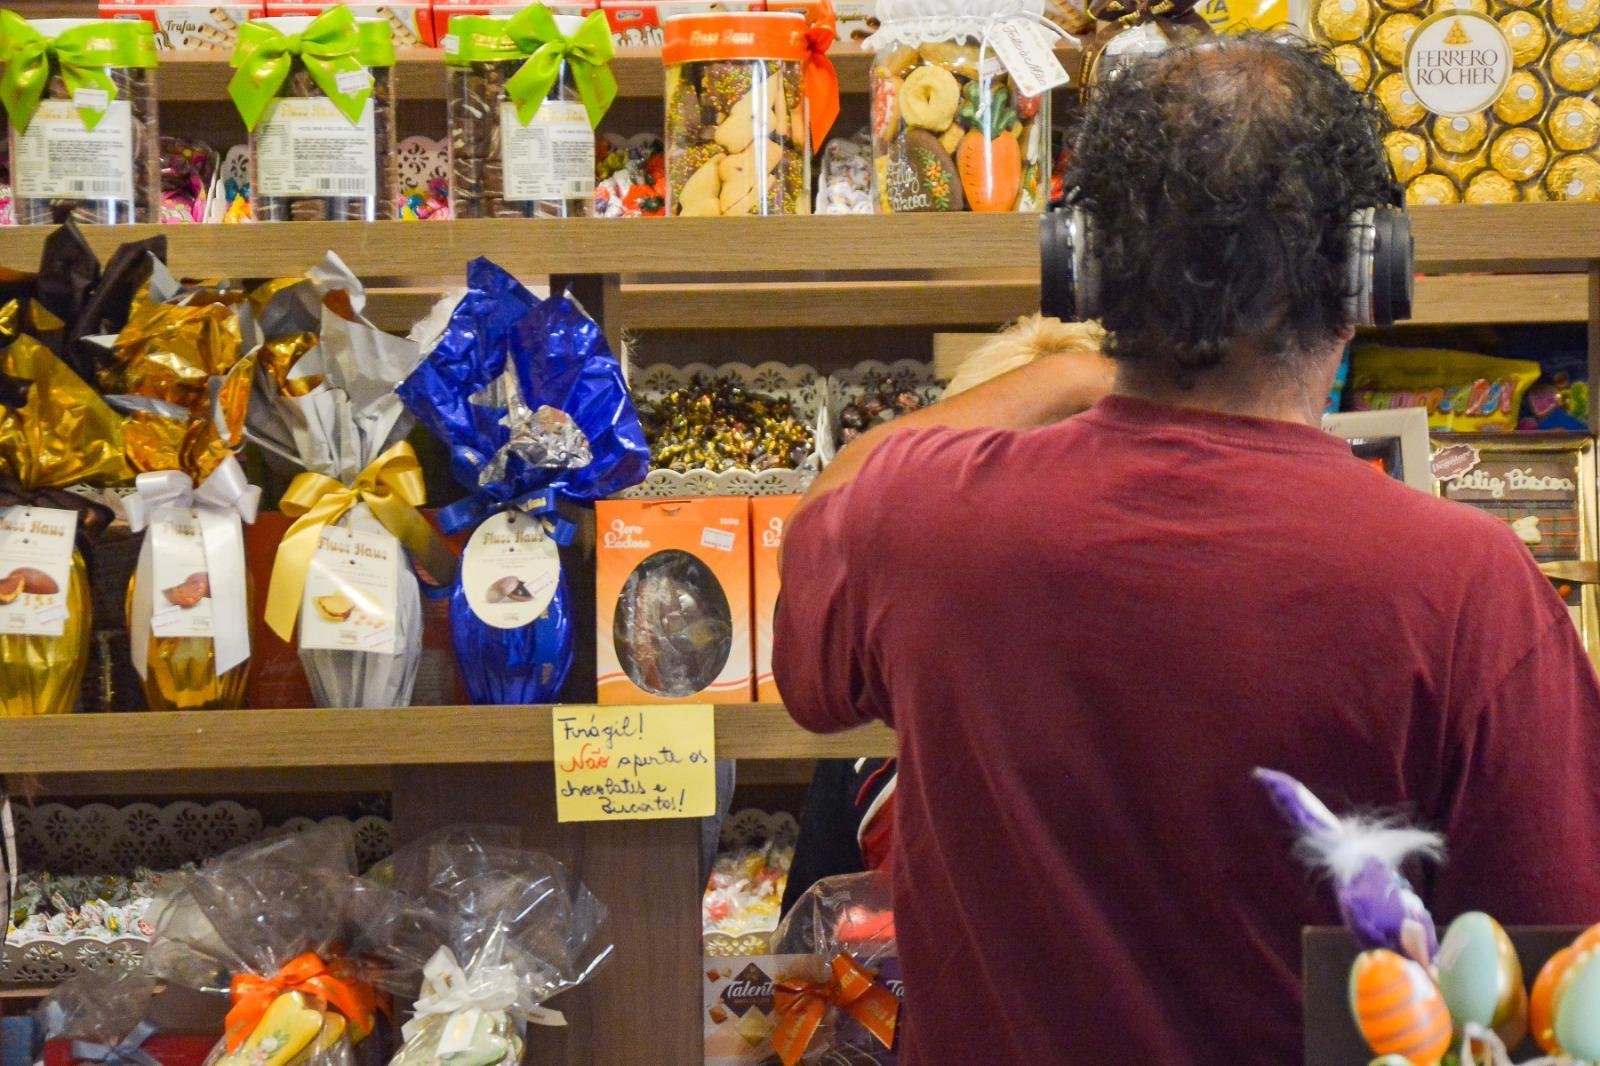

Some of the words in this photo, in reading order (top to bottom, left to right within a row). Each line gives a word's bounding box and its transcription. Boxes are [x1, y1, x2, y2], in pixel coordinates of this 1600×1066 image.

[1417, 48, 1498, 67] FERRERO
[1417, 67, 1497, 85] ROCHER
[557, 712, 643, 749] Frágil!
[560, 743, 610, 773] Não
[617, 746, 683, 776] aperte
[689, 750, 708, 764] os
[653, 783, 667, 793] e
